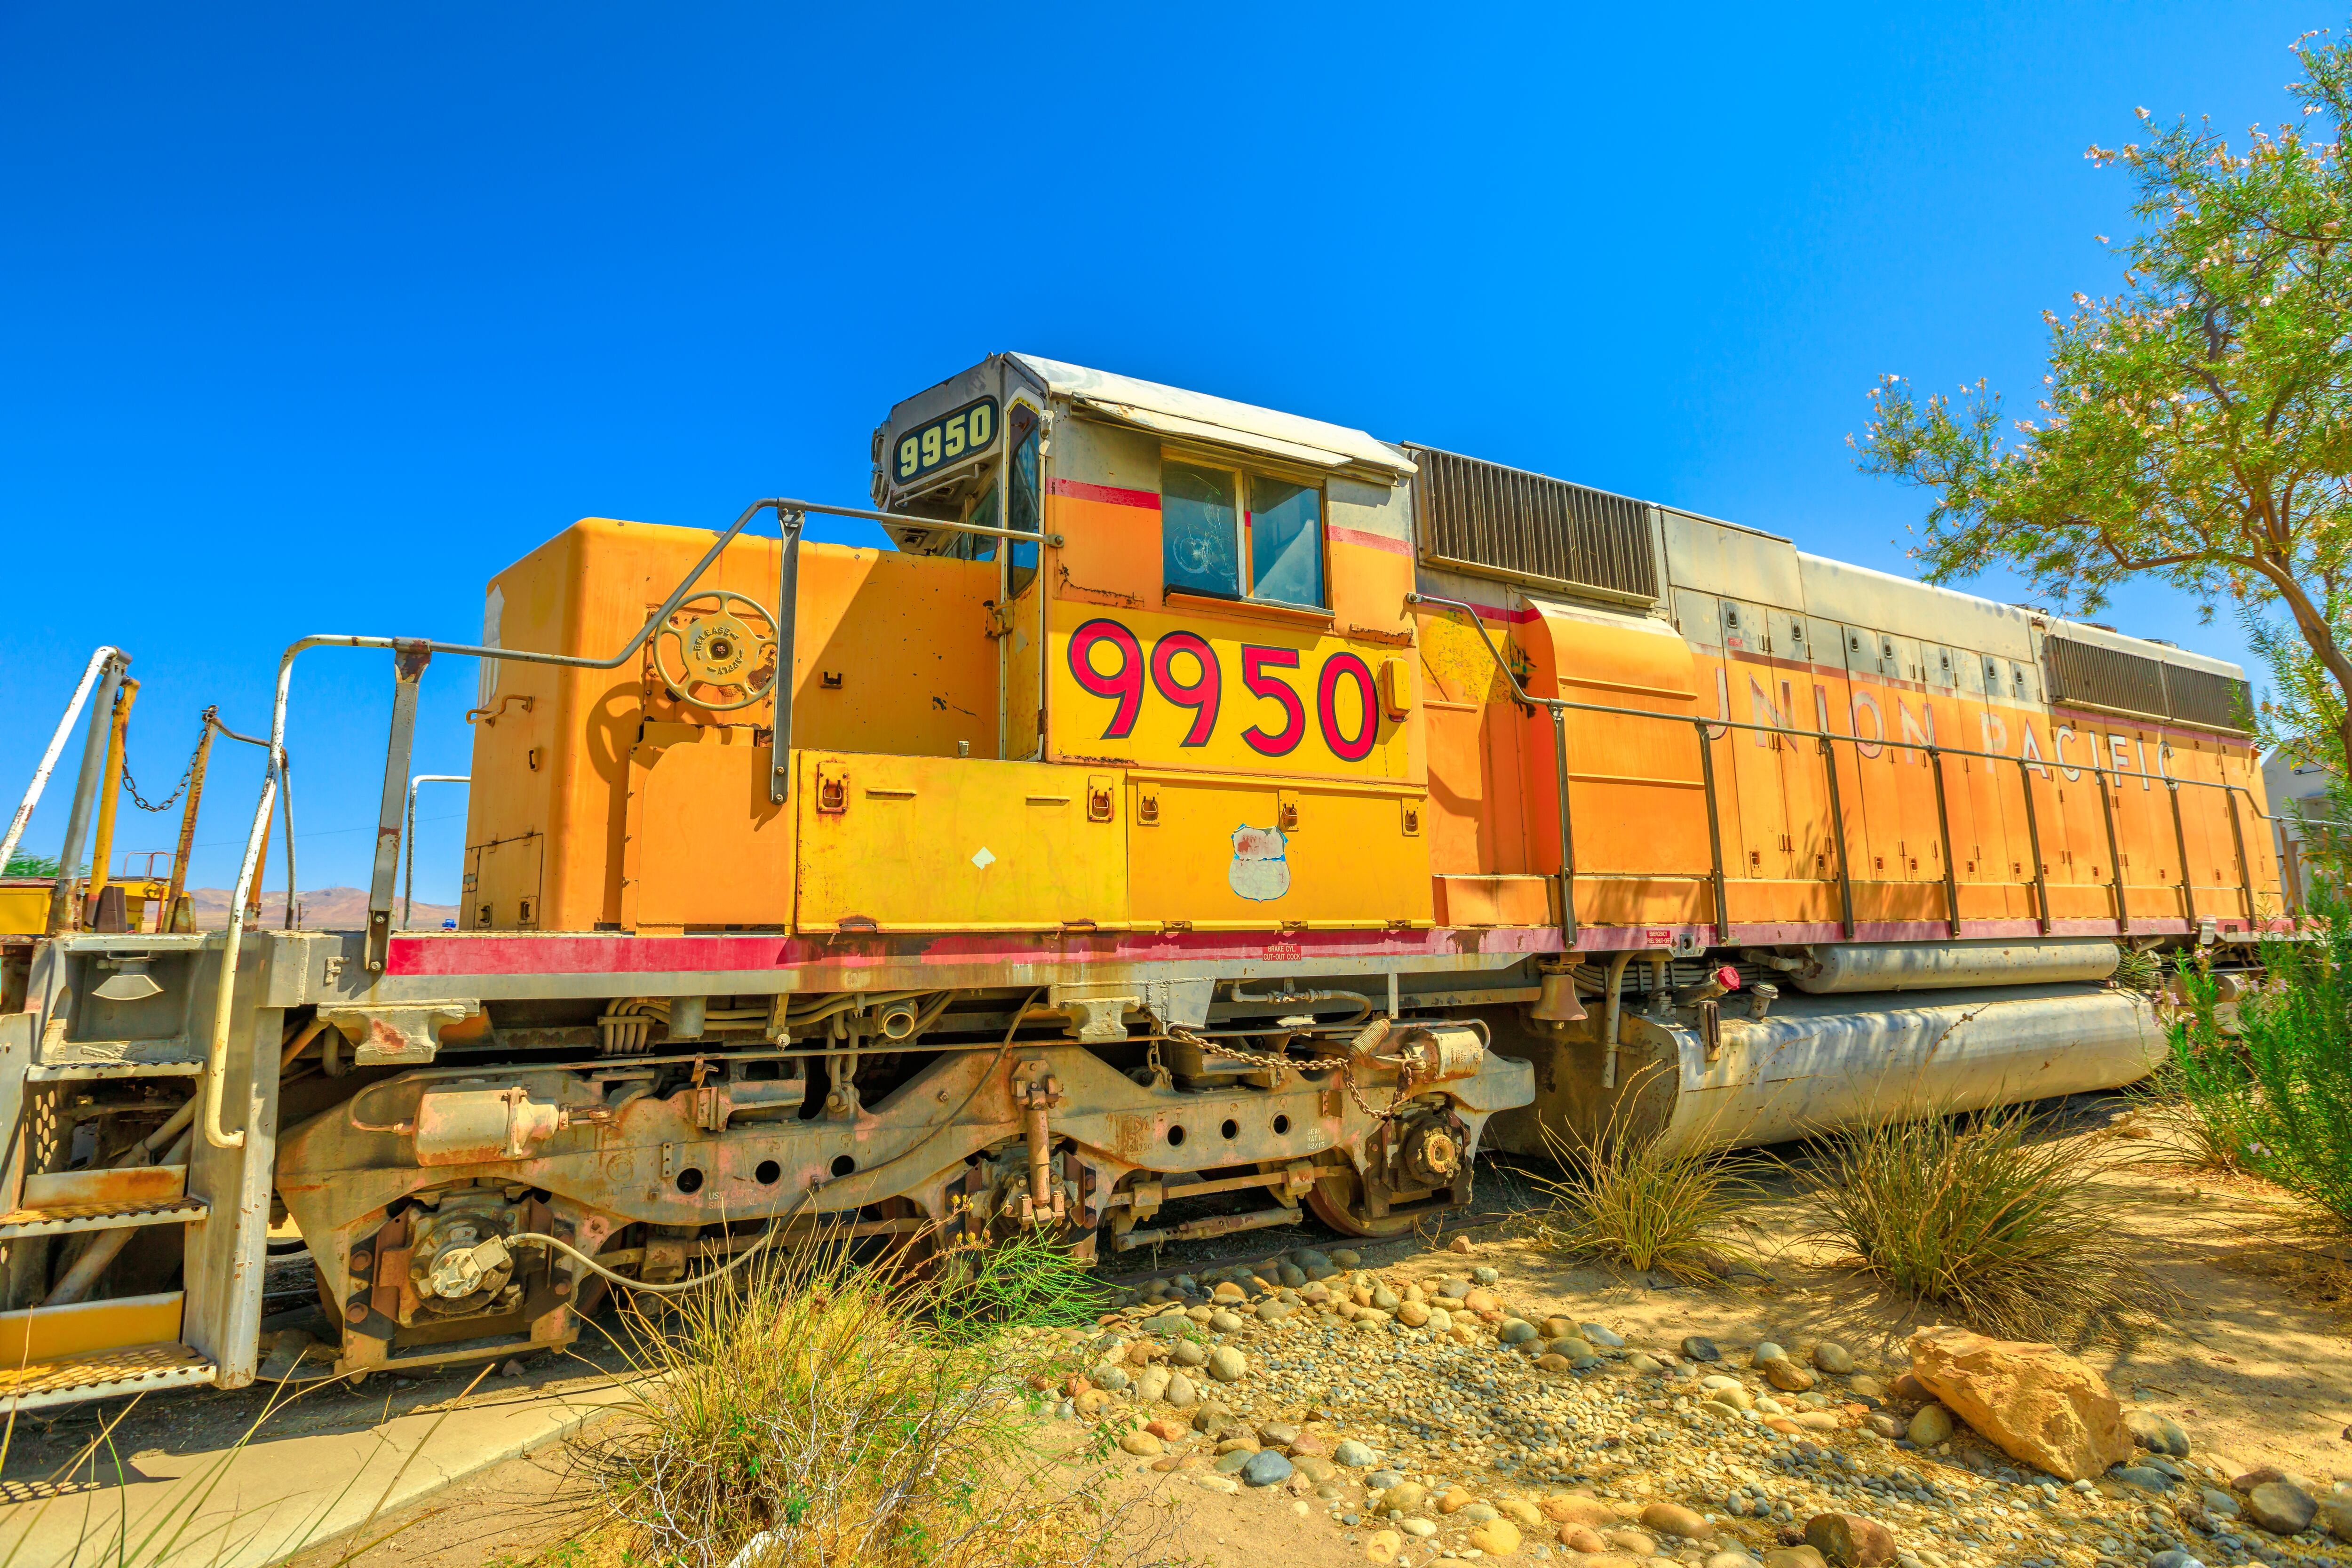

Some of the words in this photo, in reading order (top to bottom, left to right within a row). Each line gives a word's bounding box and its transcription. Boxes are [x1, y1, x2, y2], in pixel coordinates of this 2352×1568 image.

[900, 404, 990, 477] 9950
[693, 626, 731, 651] RELEASE
[717, 656, 743, 675] APPLY
[1067, 618, 1379, 763] 9950
[1979, 711, 2179, 791] PACIFIC
[324, 956, 350, 985] F
